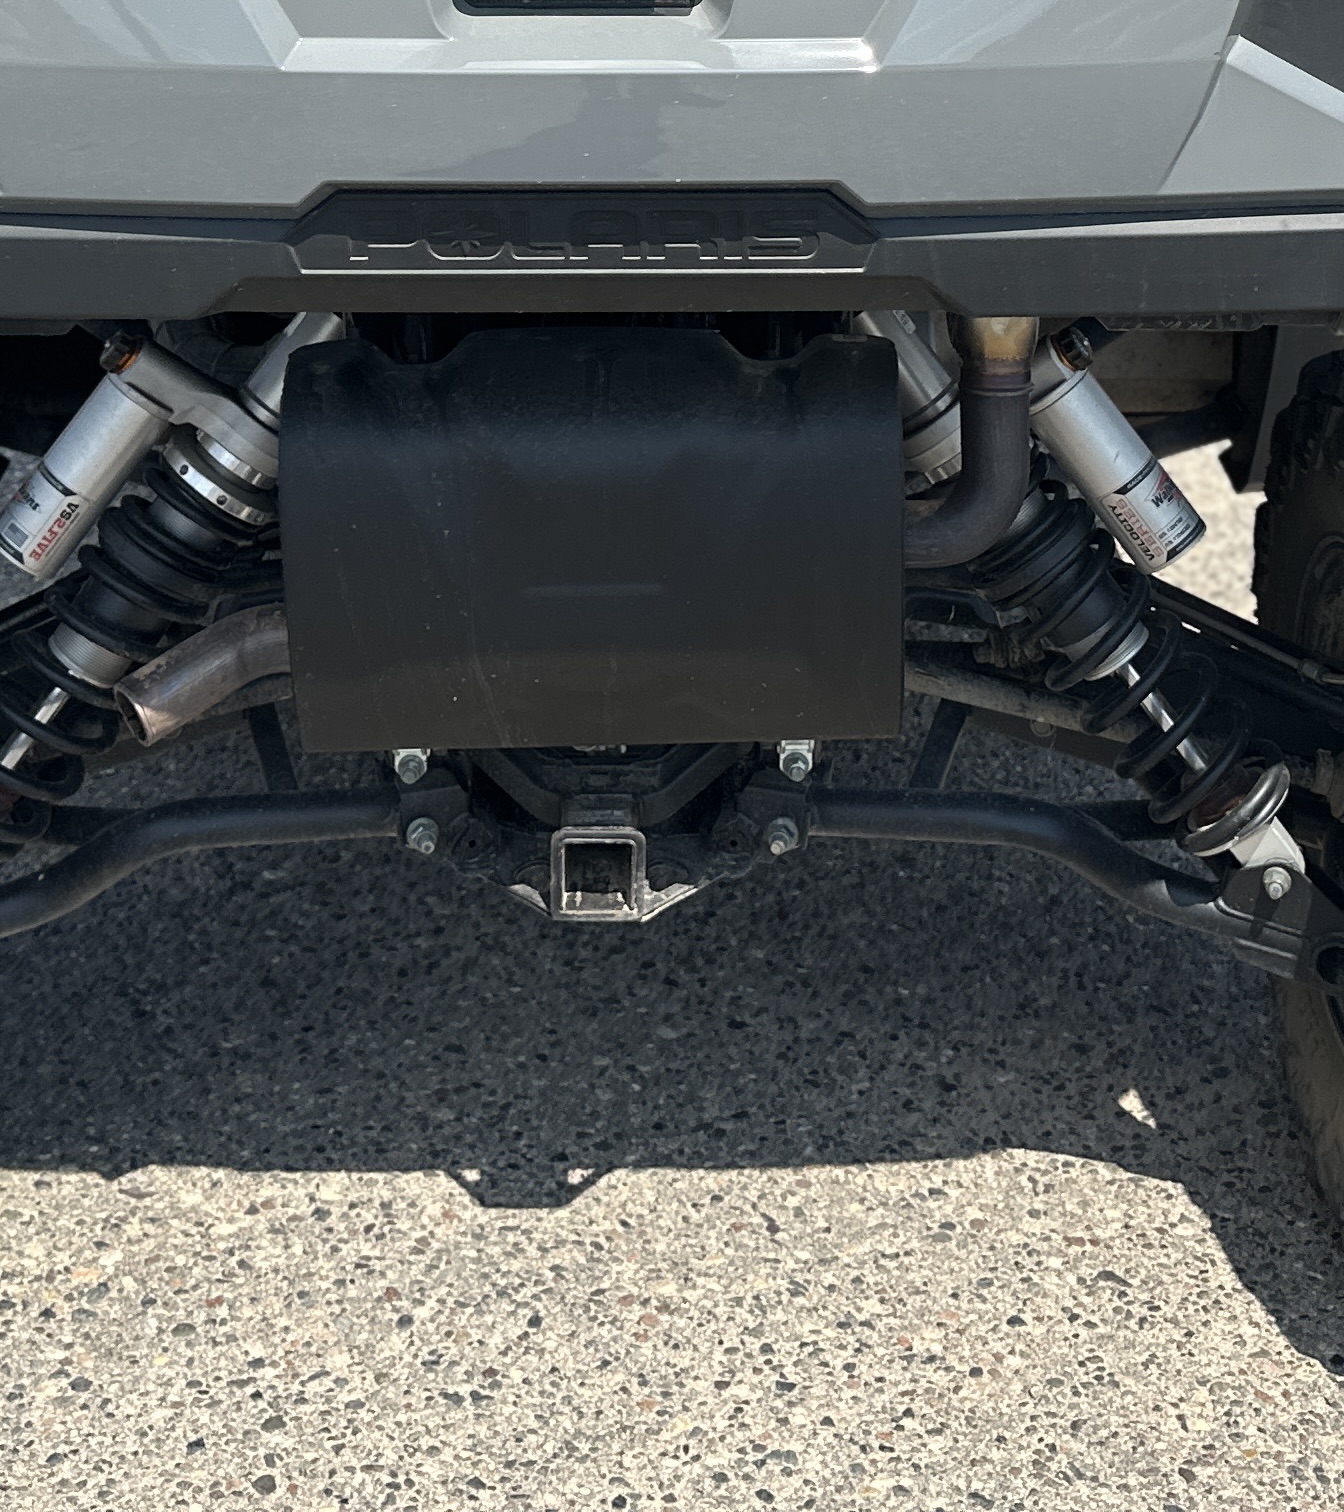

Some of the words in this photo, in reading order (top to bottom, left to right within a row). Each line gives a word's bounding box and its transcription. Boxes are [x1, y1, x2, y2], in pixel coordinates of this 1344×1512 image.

[349, 208, 822, 262] POLARIS
[1108, 505, 1155, 561] VELOCITY
[1116, 498, 1164, 558] SERIES
